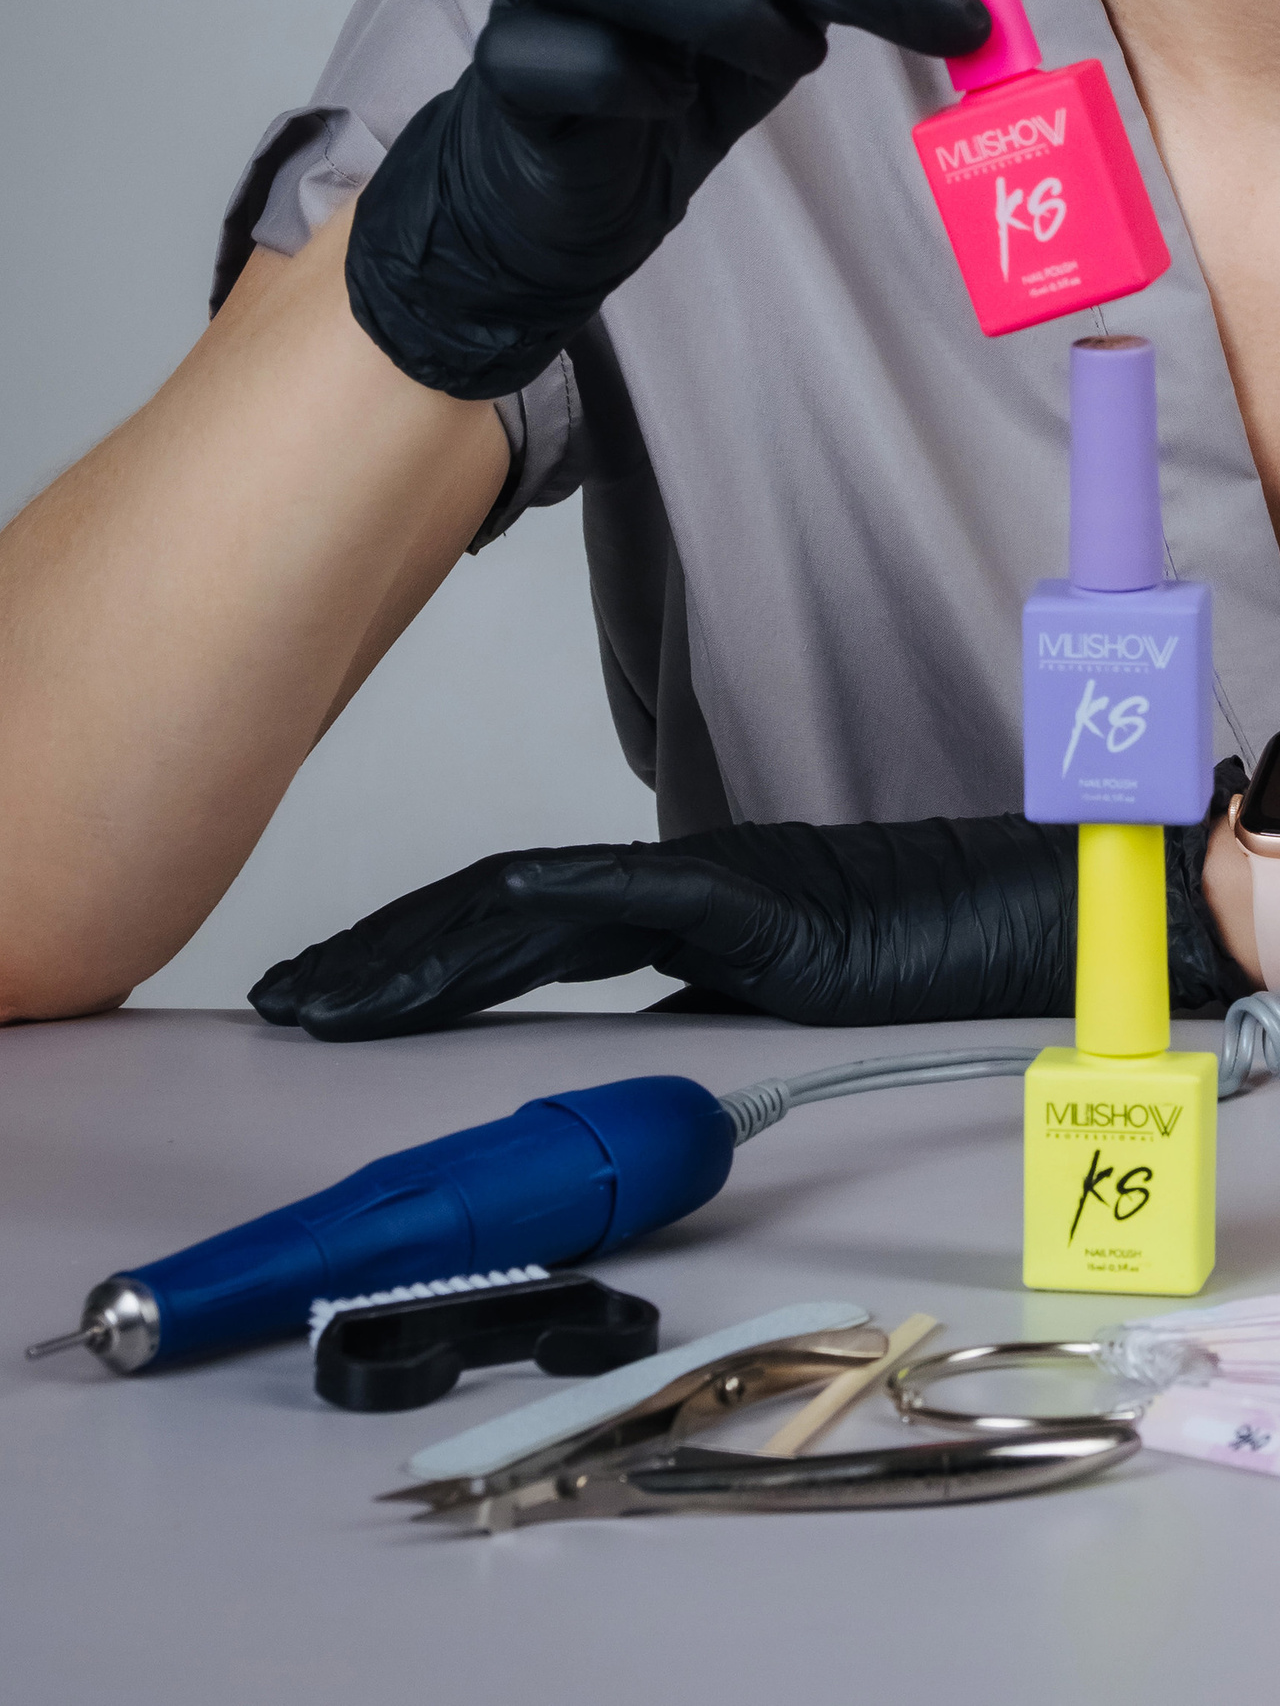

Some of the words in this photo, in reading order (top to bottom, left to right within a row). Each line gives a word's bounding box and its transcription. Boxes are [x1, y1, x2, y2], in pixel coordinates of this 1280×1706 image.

[1046, 1132, 1154, 1143] PROFESSIONAL
[1085, 1248, 1106, 1258] NAIL
[1108, 1248, 1142, 1259] POLISH
